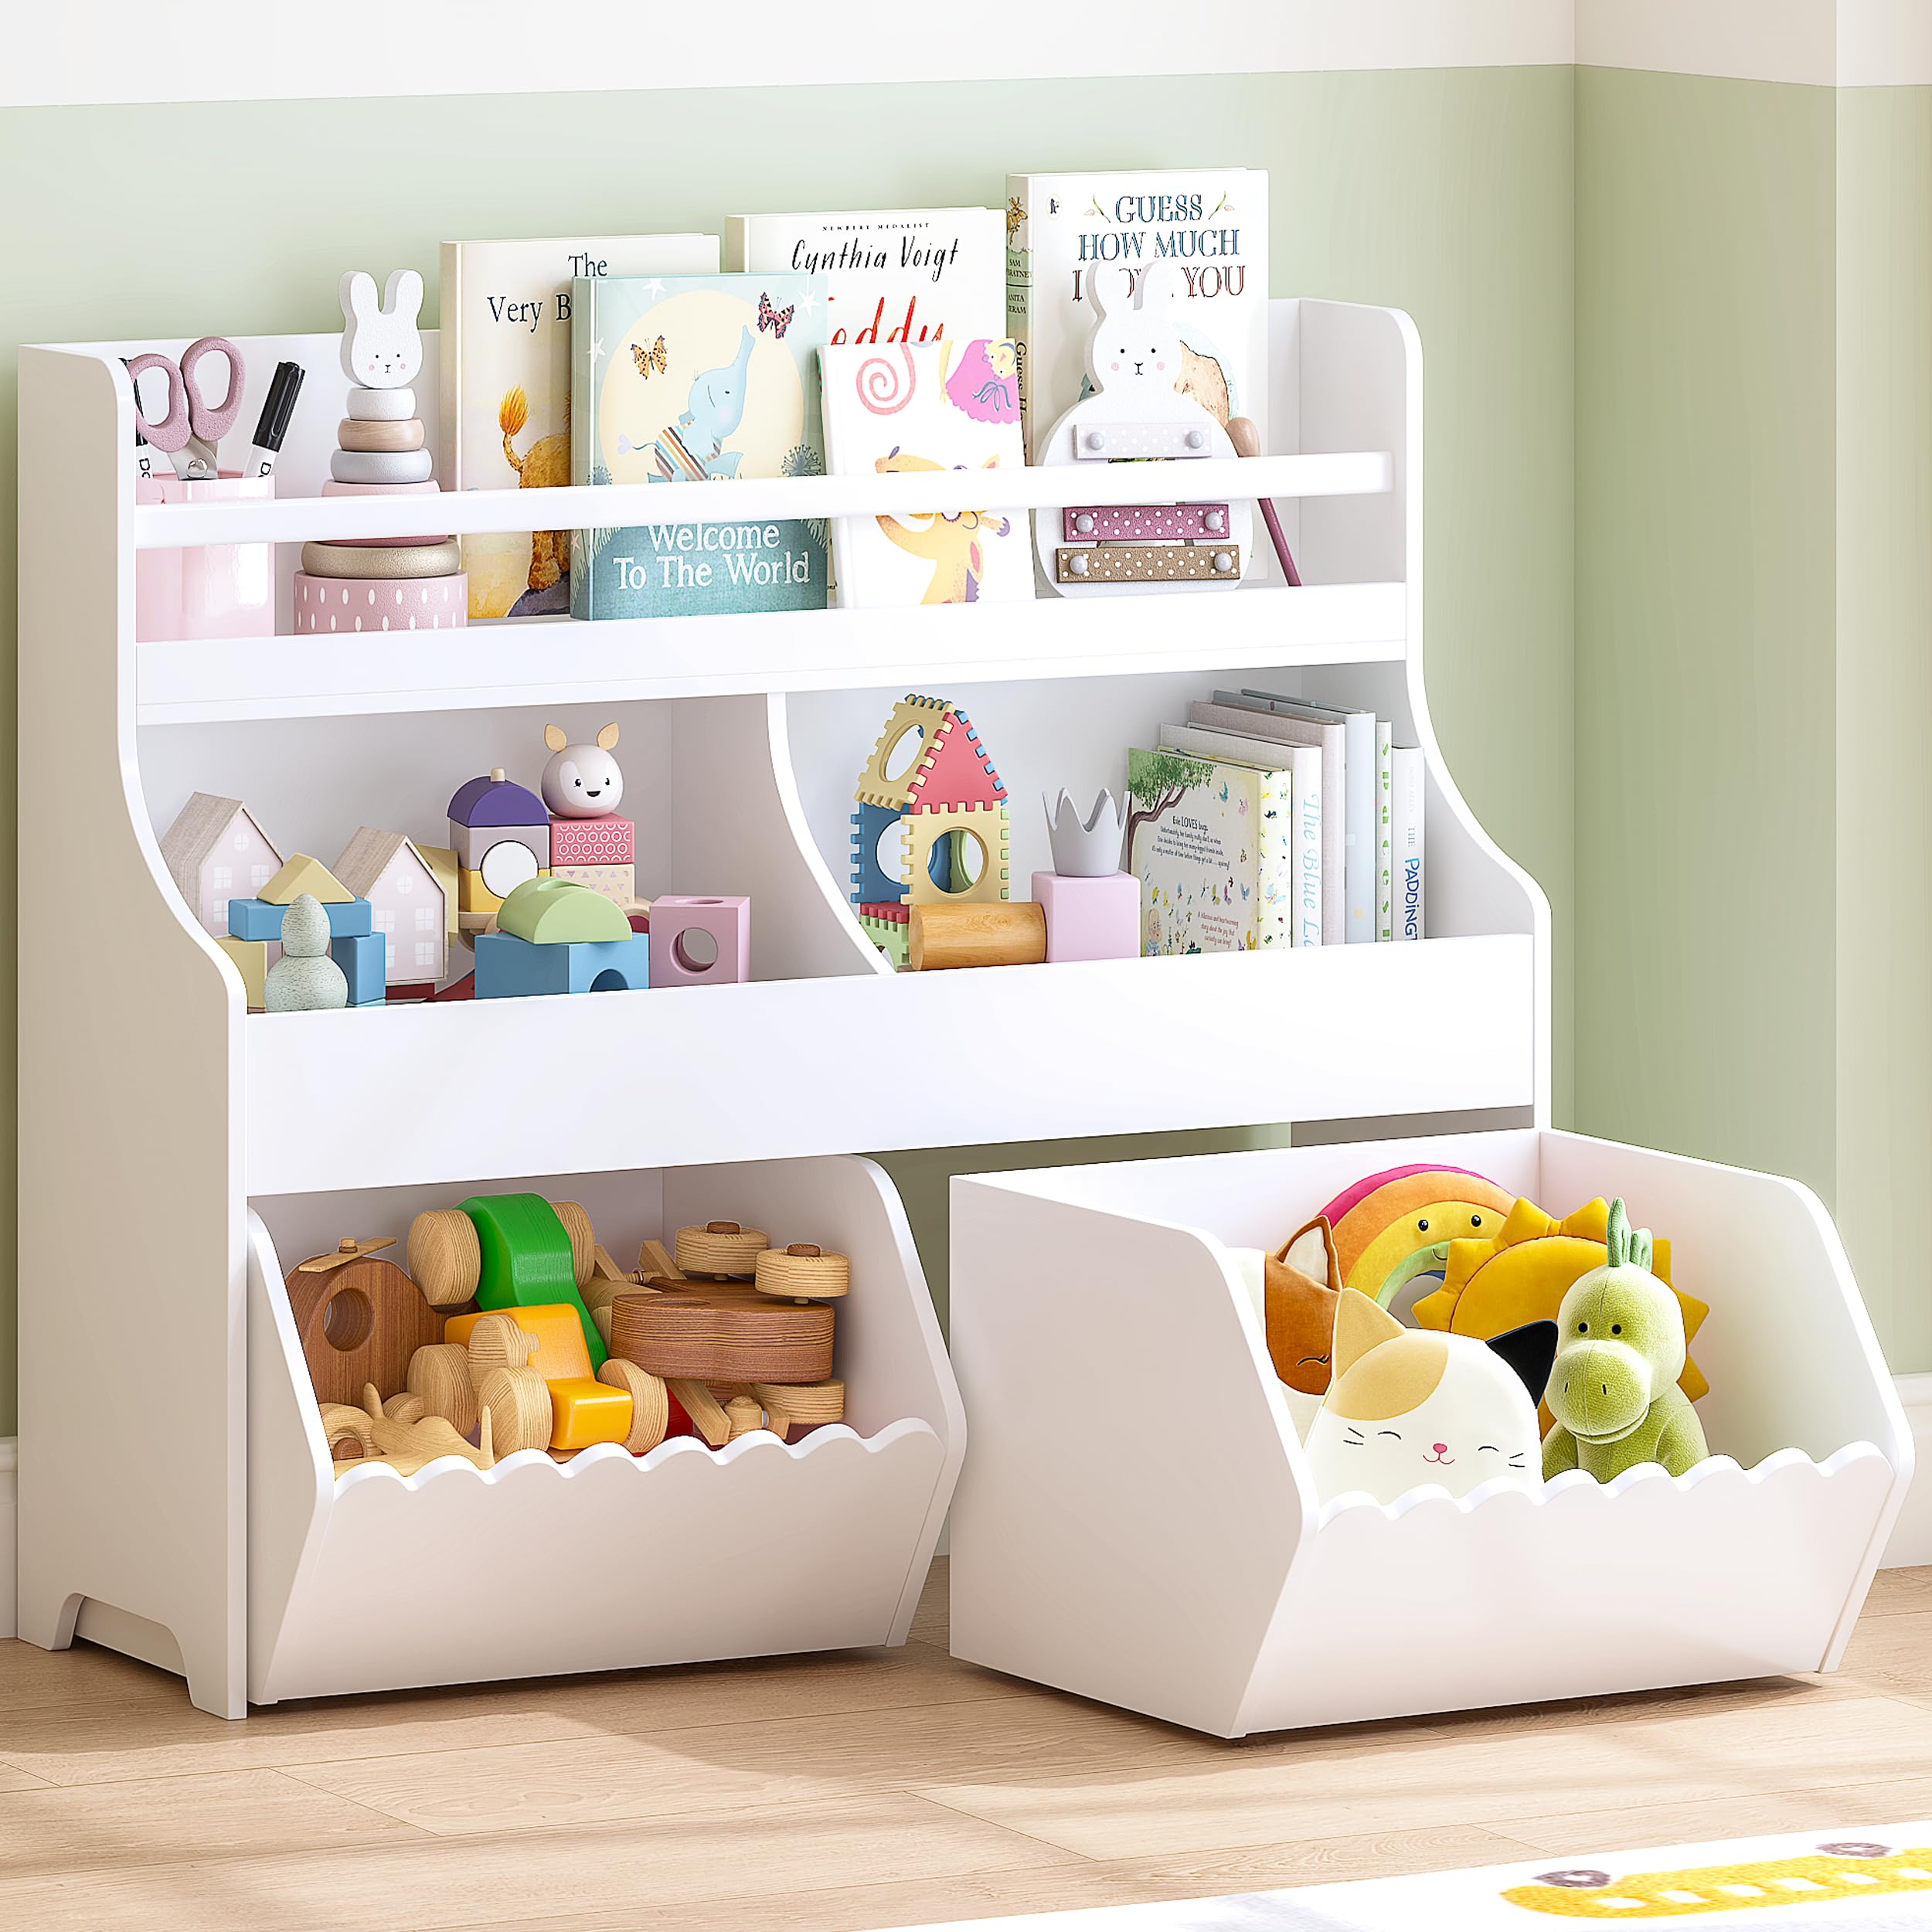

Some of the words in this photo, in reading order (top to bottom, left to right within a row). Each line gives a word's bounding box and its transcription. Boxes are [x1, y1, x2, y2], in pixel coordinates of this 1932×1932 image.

[1115, 194, 1202, 223] GUESS
[792, 237, 887, 275] Cynthia
[900, 235, 959, 282] Voigt
[1077, 232, 1147, 261] HOW
[1154, 230, 1240, 258] MUCH
[567, 252, 607, 277] The
[1071, 269, 1083, 302] I
[1180, 265, 1246, 298] YOU
[487, 296, 543, 334] Very
[556, 293, 572, 321] B
[648, 523, 781, 552] Welcome
[613, 556, 647, 590] To
[656, 555, 713, 589] The
[723, 551, 811, 586] World
[1182, 816, 1198, 829] LOVES
[1303, 794, 1321, 840] The
[1302, 849, 1321, 909] Blue
